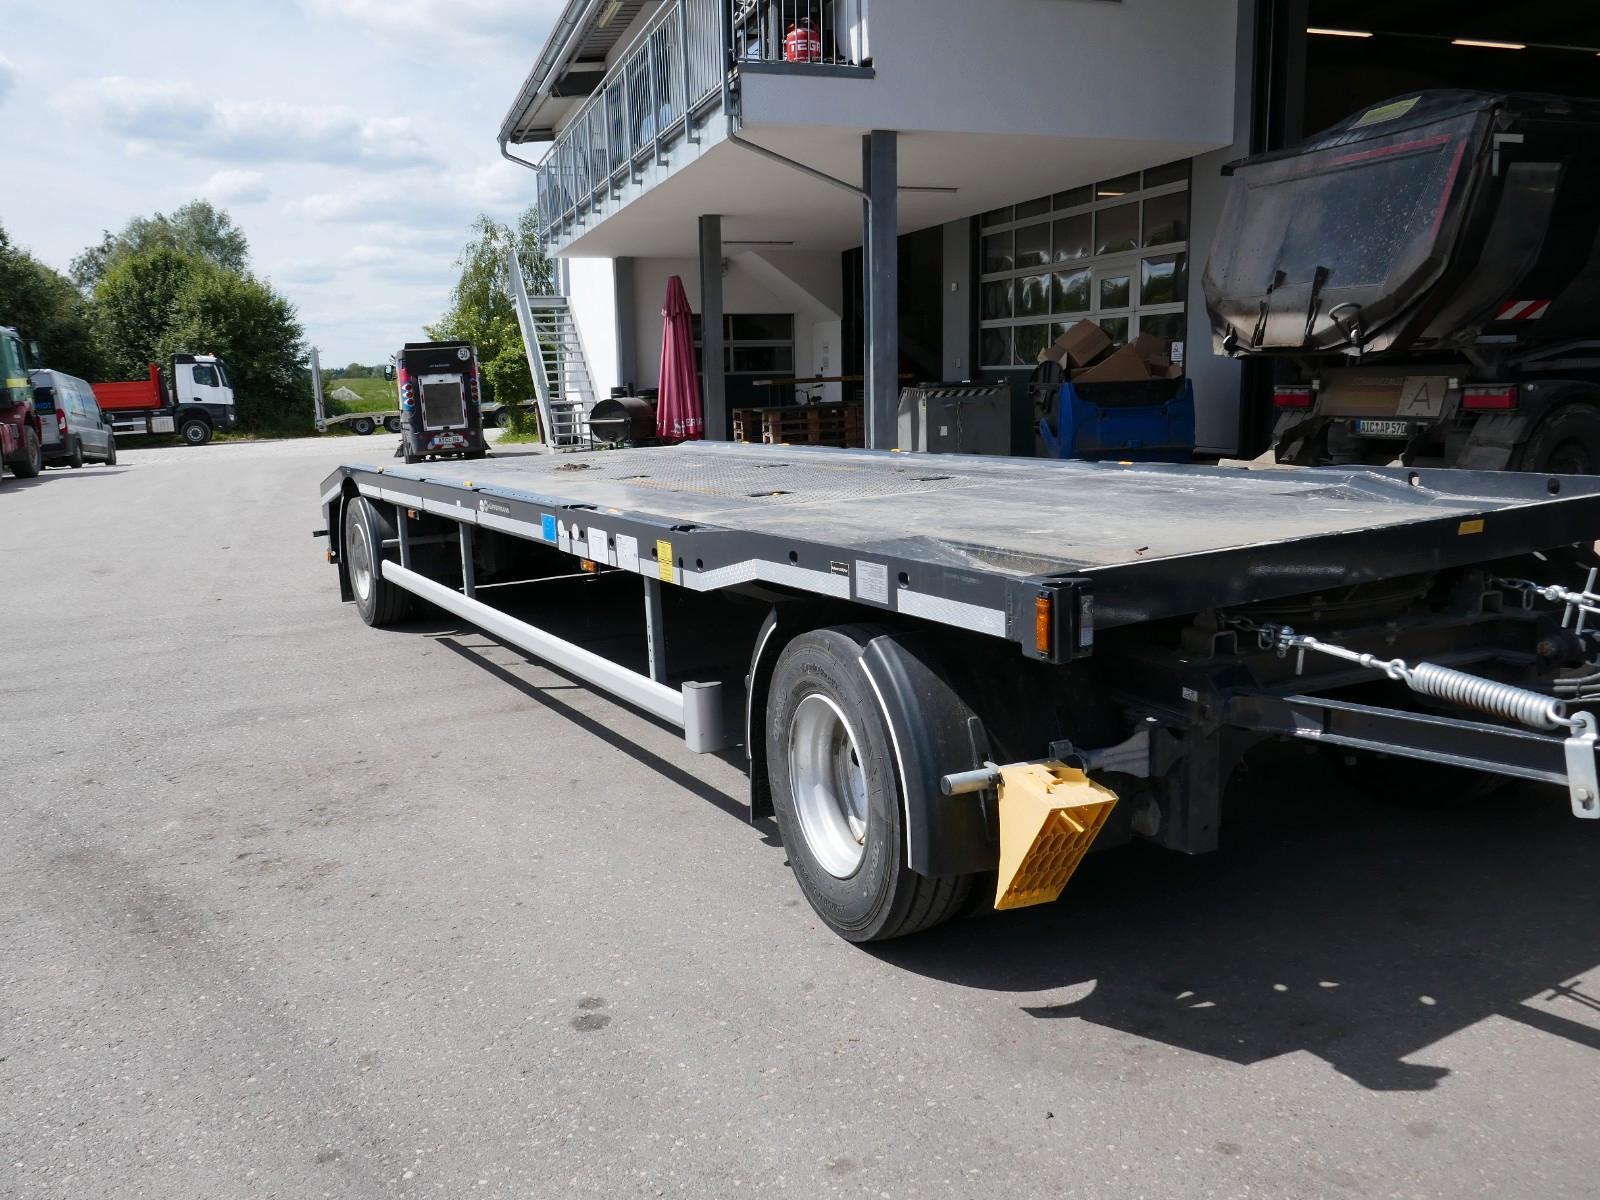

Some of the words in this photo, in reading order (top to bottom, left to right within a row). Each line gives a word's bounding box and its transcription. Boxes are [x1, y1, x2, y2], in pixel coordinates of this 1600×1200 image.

[460, 348, 468, 359] 50
[1407, 382, 1431, 411] A
[1360, 421, 1375, 433] AIC
[1379, 422, 1390, 434] AP
